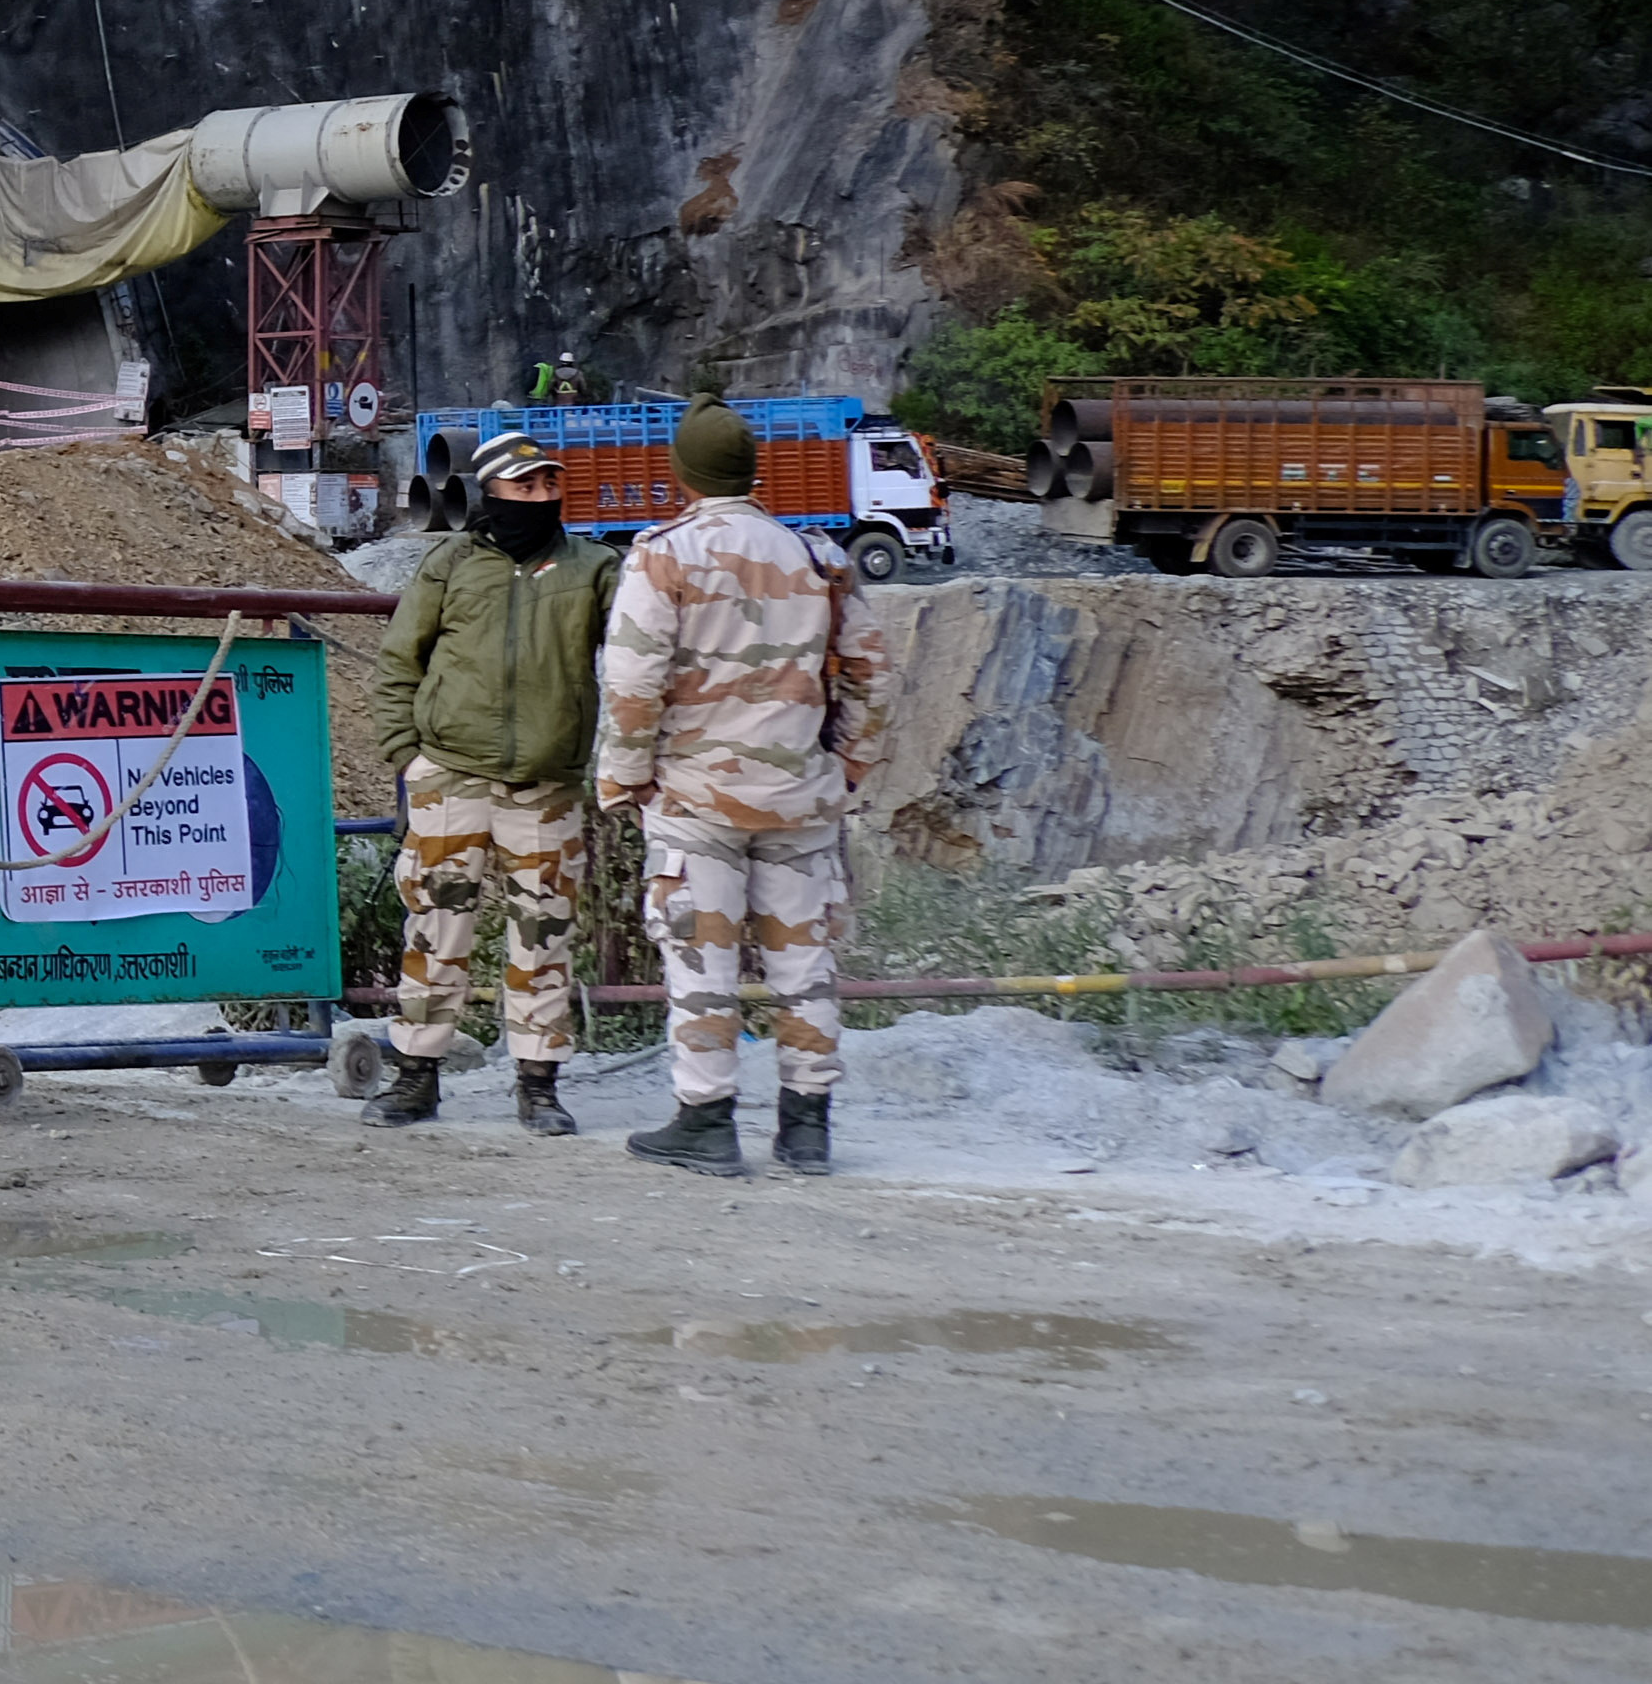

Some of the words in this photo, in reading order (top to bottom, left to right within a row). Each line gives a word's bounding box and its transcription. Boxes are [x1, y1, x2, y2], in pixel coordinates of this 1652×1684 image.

[251, 664, 295, 701] पुलिस
[52, 688, 231, 729] WARNING
[160, 765, 235, 788] Vehicles
[130, 794, 200, 820] Beyond
[131, 825, 172, 846] This
[179, 823, 227, 844] Point
[20, 884, 66, 905] आज्ञा
[72, 875, 90, 901] से
[112, 870, 192, 900] उत्तरकाशी
[198, 867, 246, 901] पुलिस
[40, 944, 111, 983] प्राधिकरण
